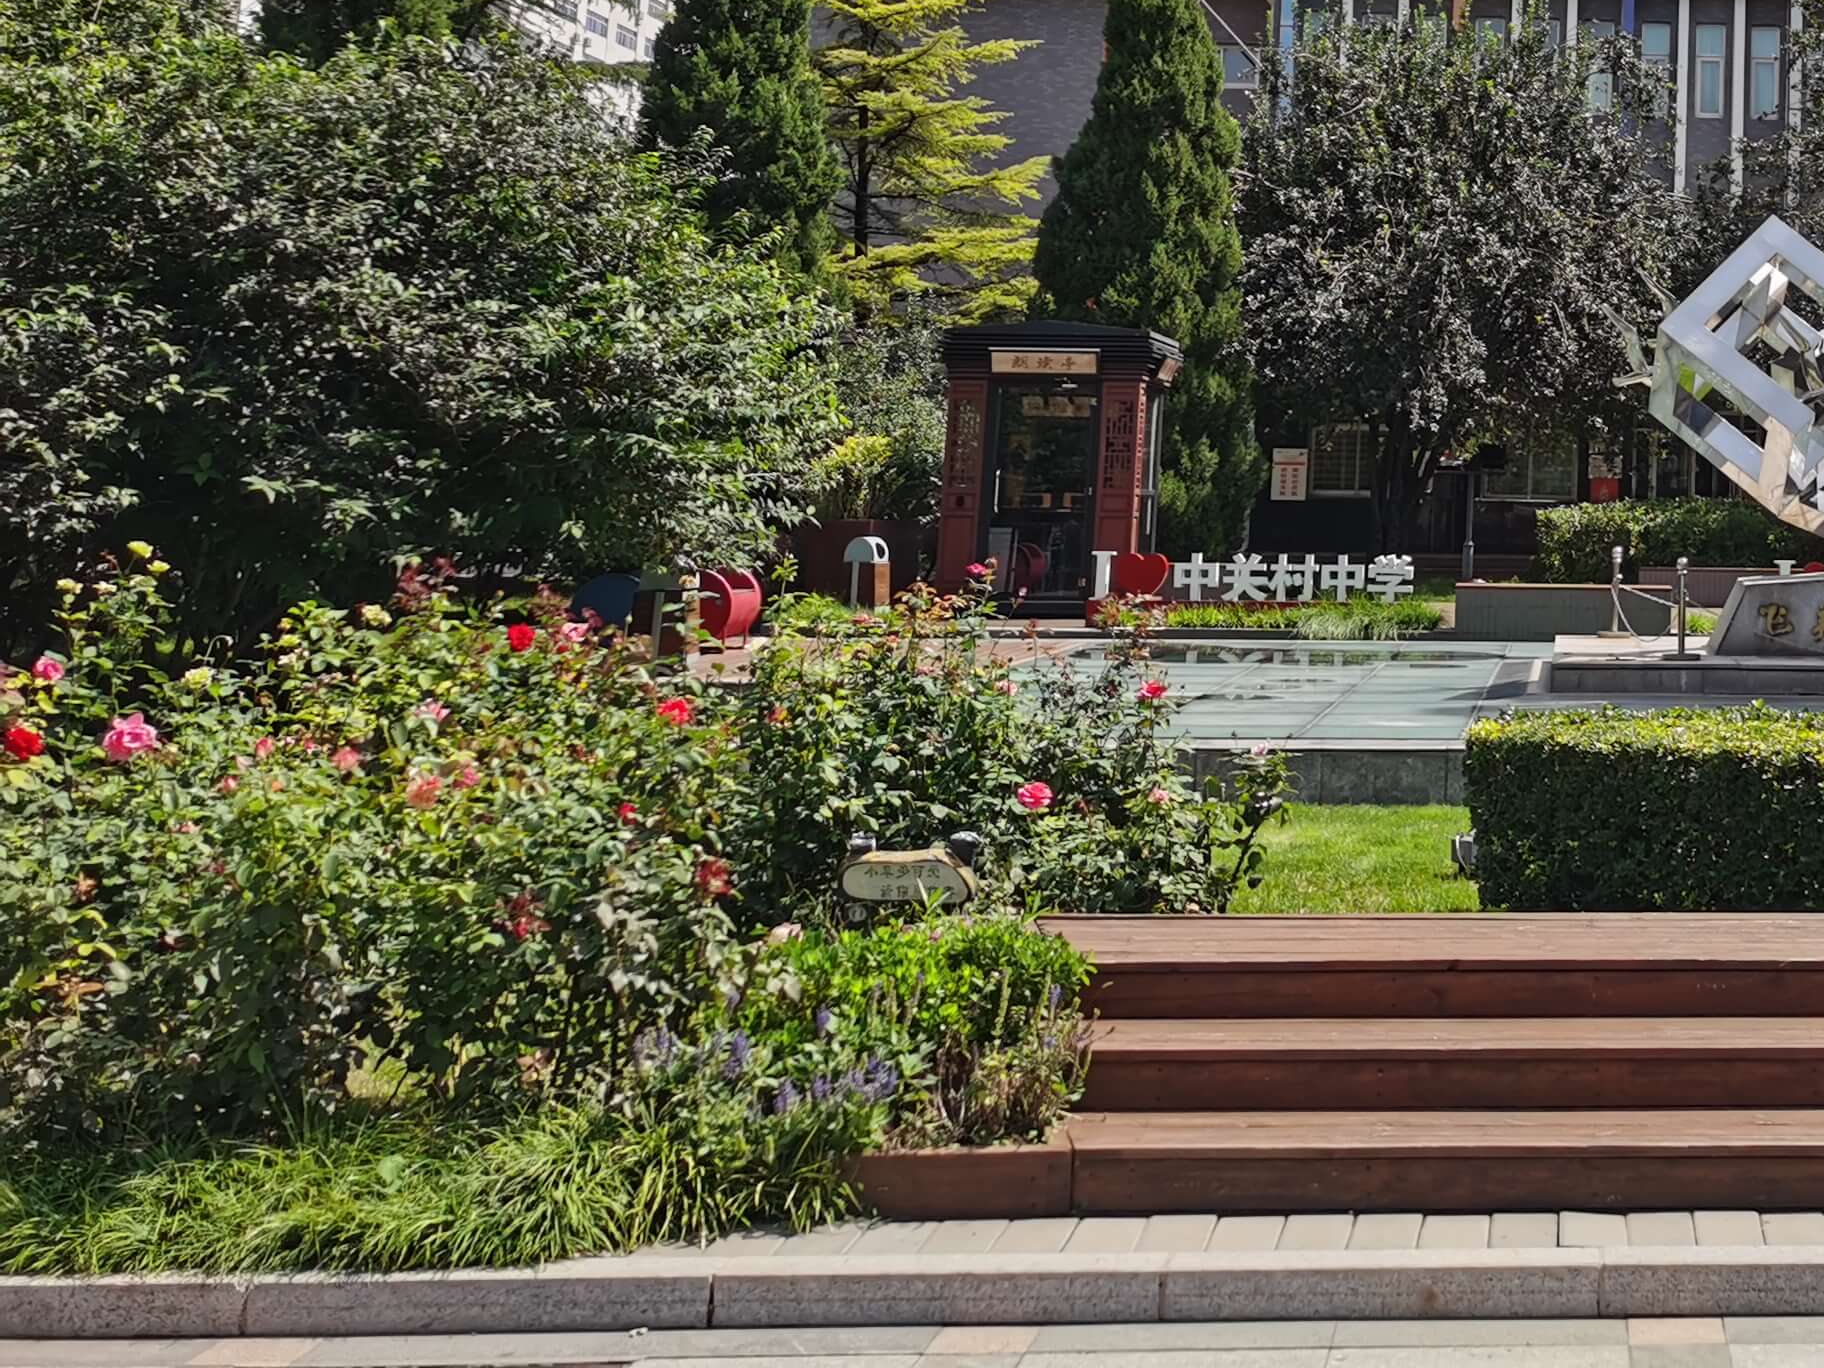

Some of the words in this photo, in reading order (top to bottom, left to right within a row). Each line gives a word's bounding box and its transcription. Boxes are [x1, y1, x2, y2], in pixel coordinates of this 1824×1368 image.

[1089, 551, 1117, 600] I
[1173, 552, 1414, 602] 中关村中学
